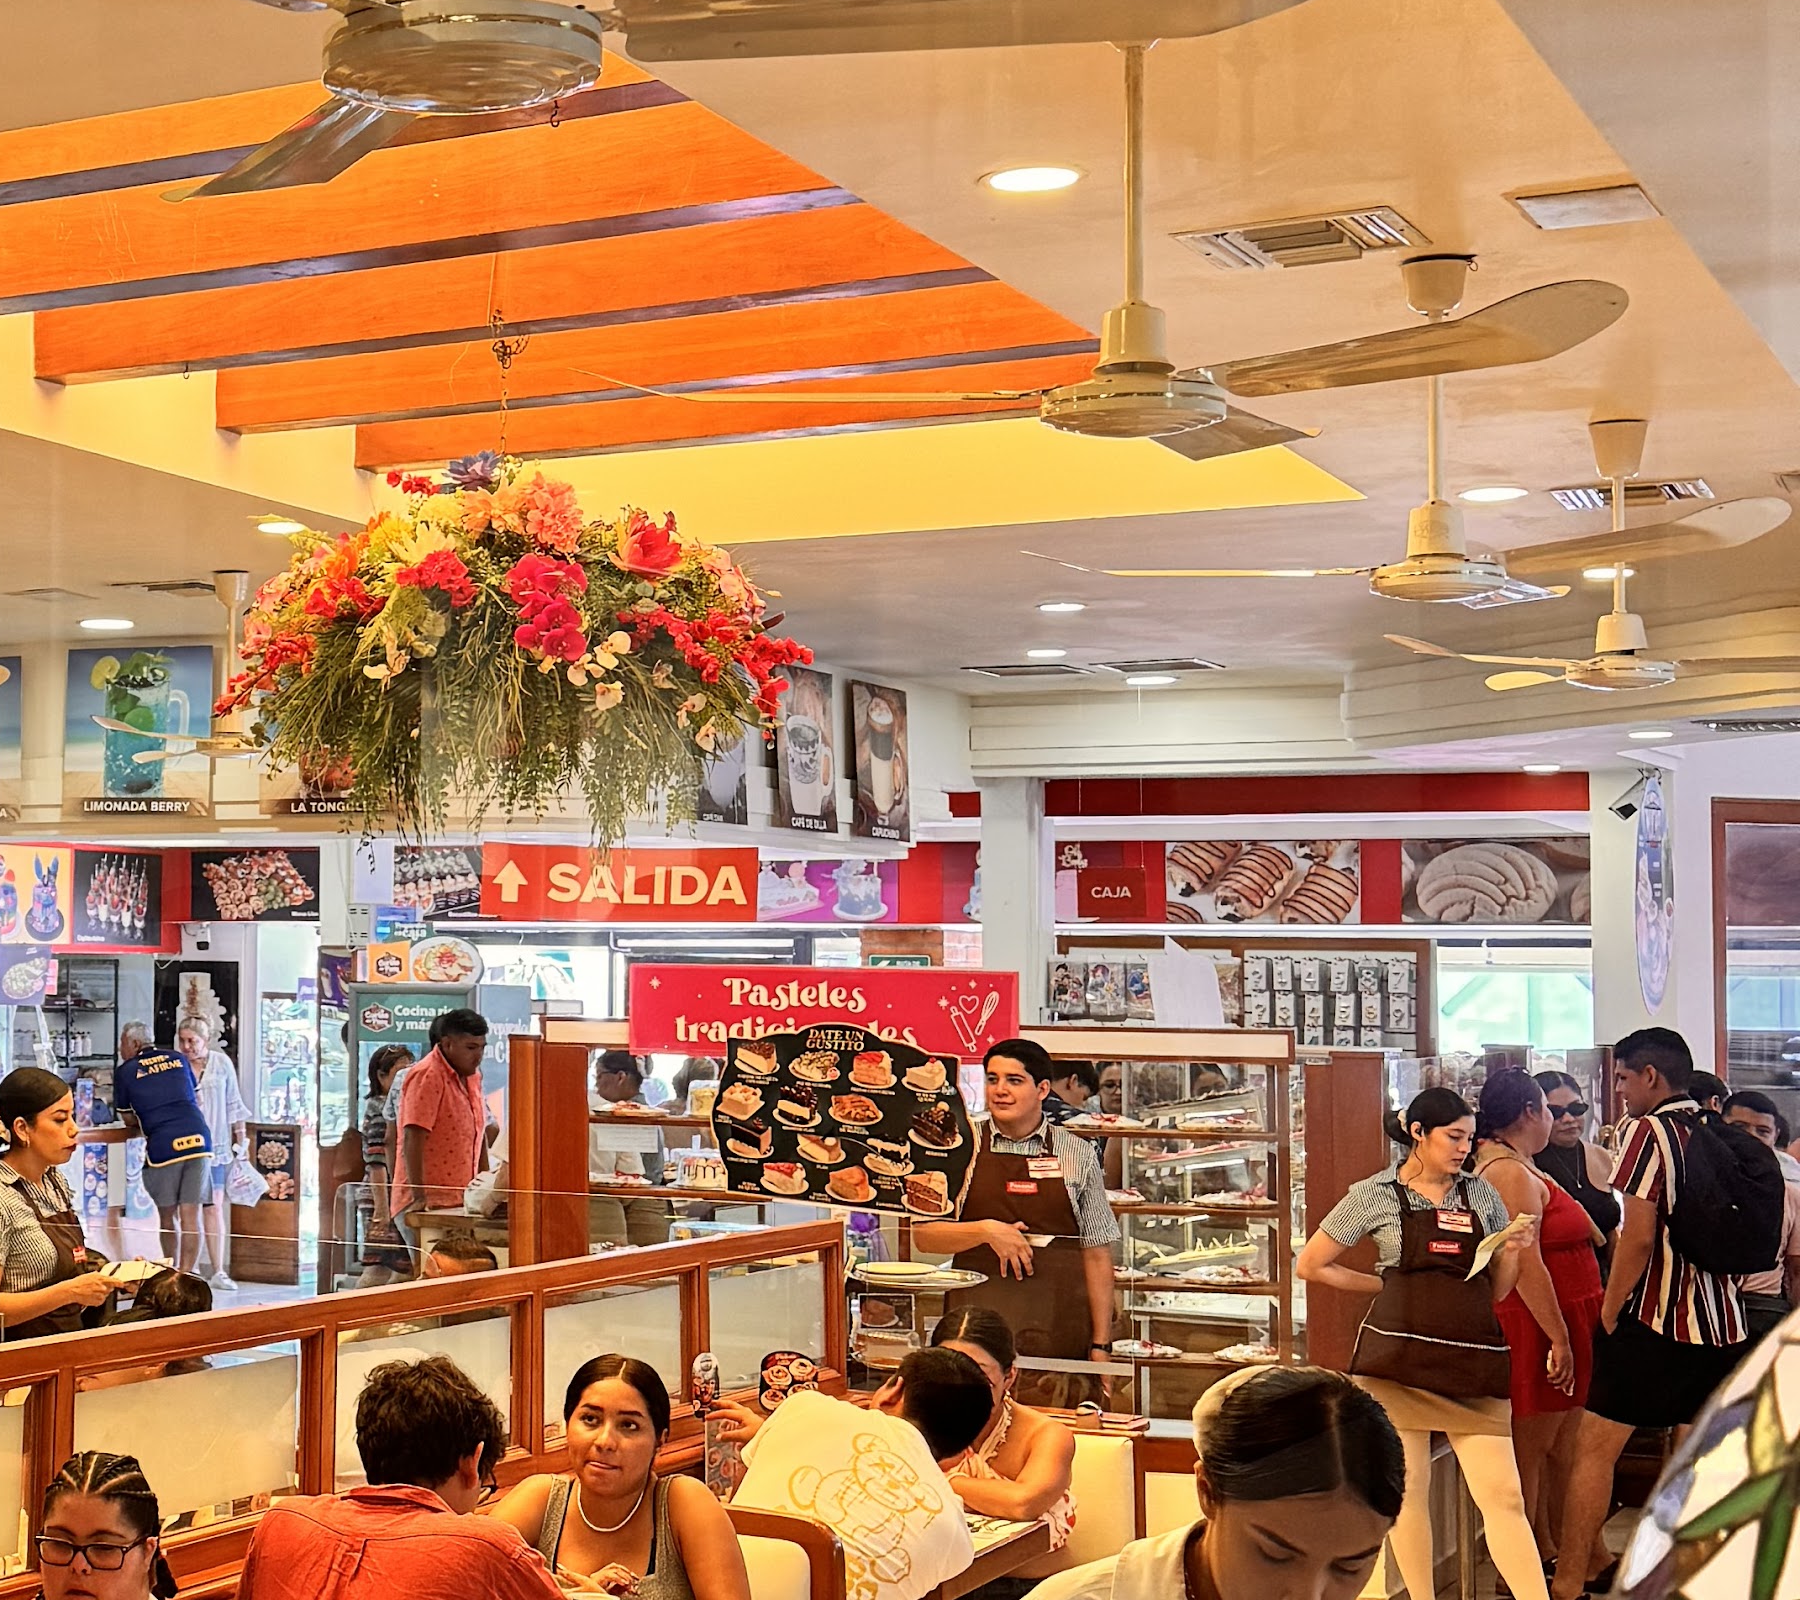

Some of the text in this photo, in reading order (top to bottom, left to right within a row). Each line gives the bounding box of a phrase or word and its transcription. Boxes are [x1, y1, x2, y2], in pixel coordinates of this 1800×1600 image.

[83, 801, 190, 812] LIMONADA BERRY
[290, 802, 307, 813] LA
[547, 862, 748, 906] SALIDA
[1091, 886, 1132, 899] CAJA
[722, 977, 867, 1013] Pasteles
[394, 1005, 453, 1016] Cocina ri
[395, 1020, 405, 1032] y
[808, 1029, 865, 1042] DATE UN
[806, 1038, 865, 1051] GUSTITO
